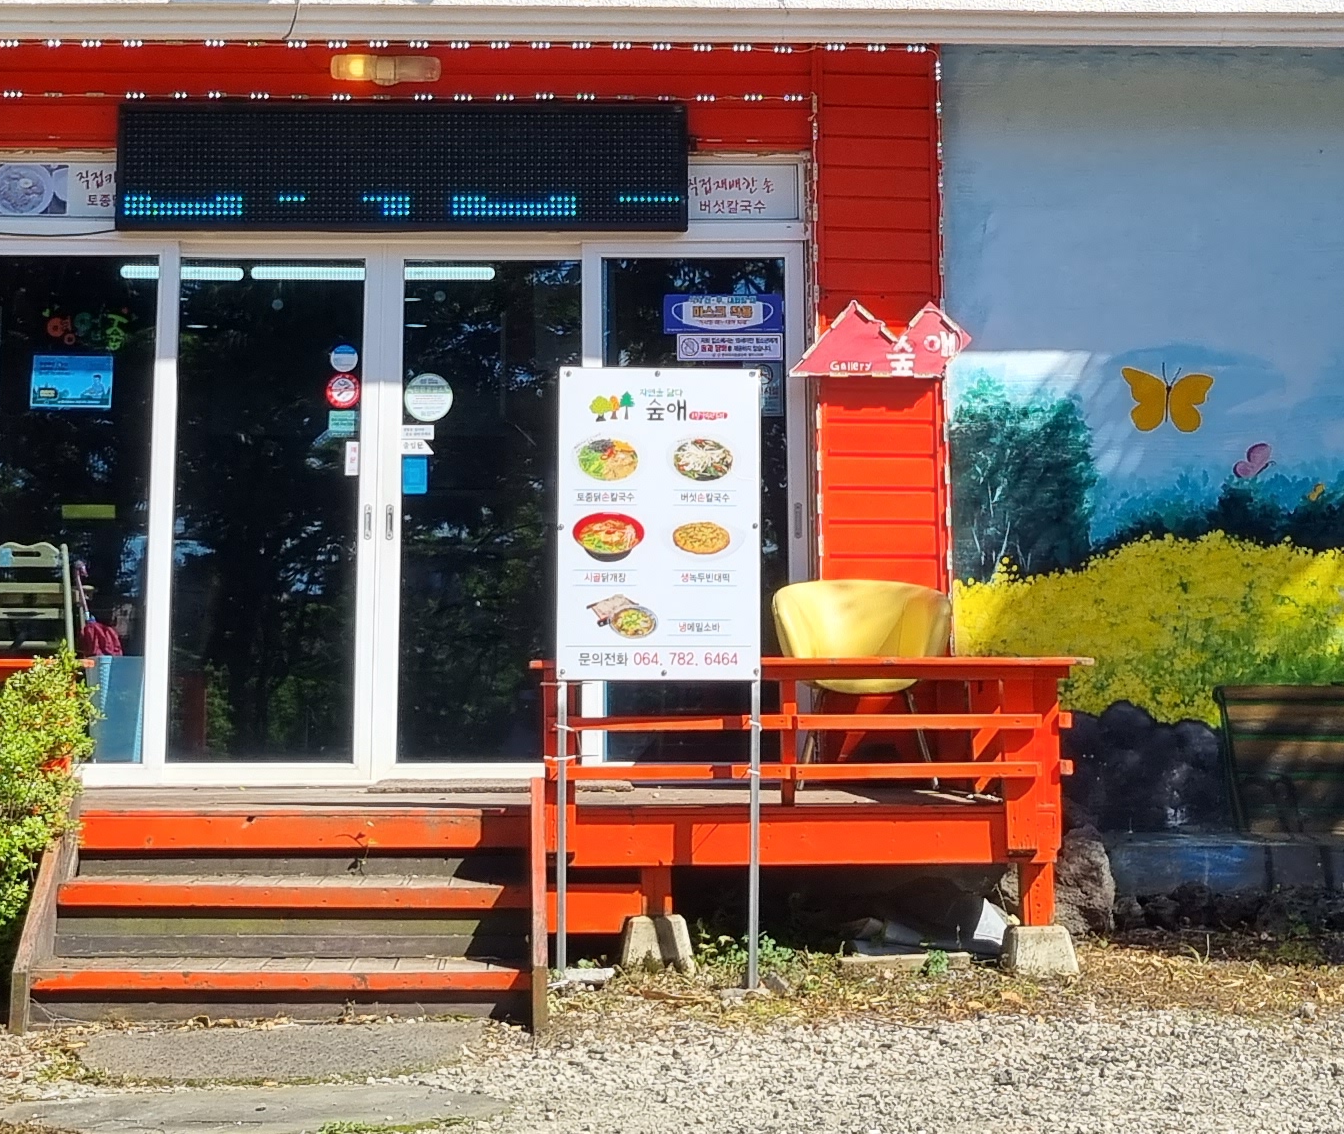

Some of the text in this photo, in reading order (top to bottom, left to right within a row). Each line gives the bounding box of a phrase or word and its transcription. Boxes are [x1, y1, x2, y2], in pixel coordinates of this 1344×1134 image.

[699, 200, 767, 214] 버섯칼국수
[830, 361, 872, 372] Gallery
[645, 398, 687, 421] 숲애
[680, 492, 731, 503] 버섯손칼국수
[584, 572, 626, 583] 시골닭개장
[680, 572, 730, 583] 생녹두빈대떡
[678, 622, 721, 633] 냉메밀소바
[578, 652, 629, 666] 문의전화
[704, 652, 738, 666] 6464
